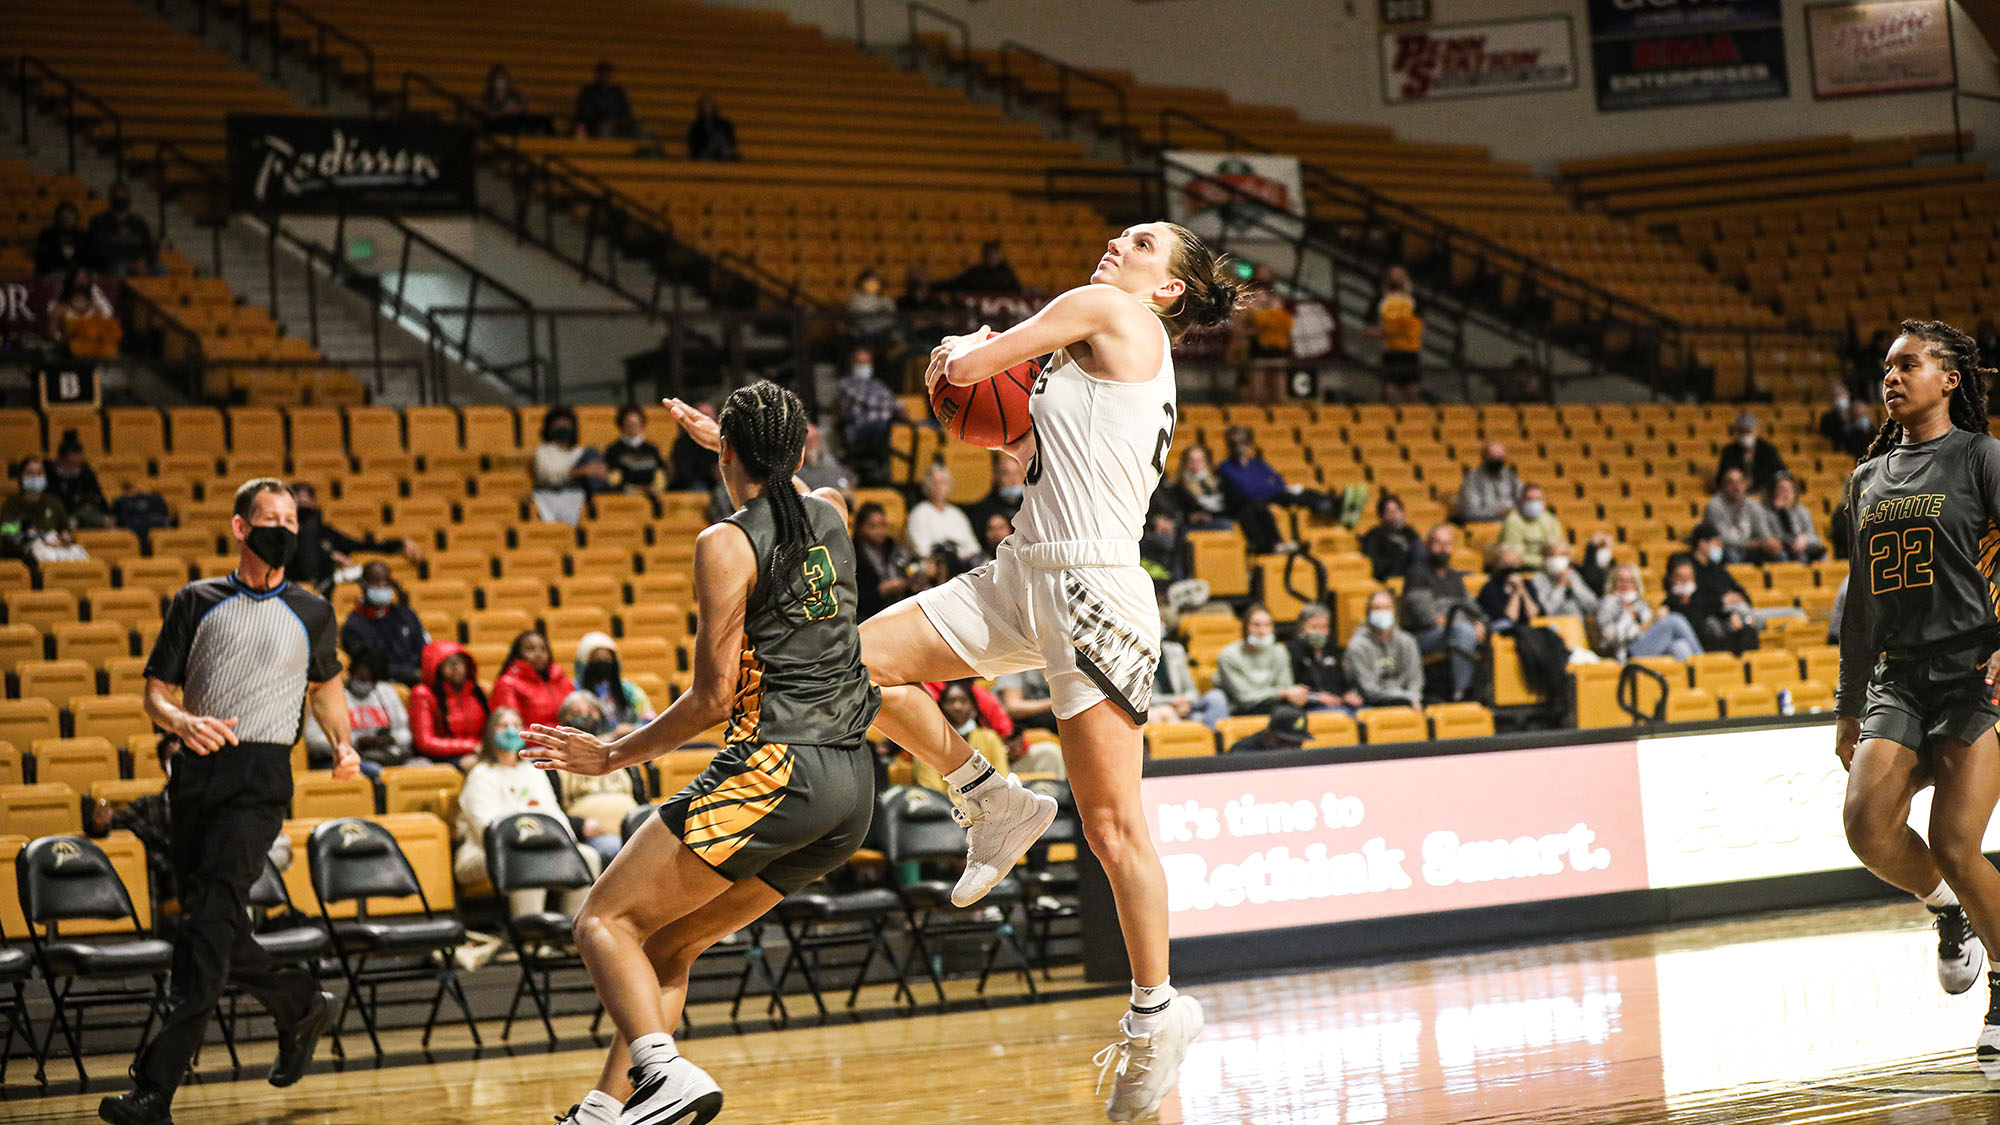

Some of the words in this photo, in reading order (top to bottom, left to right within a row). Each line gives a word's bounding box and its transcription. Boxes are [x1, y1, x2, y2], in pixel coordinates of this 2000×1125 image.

[59, 371, 80, 398] B
[803, 545, 838, 621] 3
[1869, 526, 1935, 596] 22
[1158, 799, 1222, 843] It's
[1223, 793, 1318, 837] time
[1320, 792, 1365, 830] to
[1160, 836, 1413, 912] Rethink
[1421, 822, 1612, 887] Smart.
